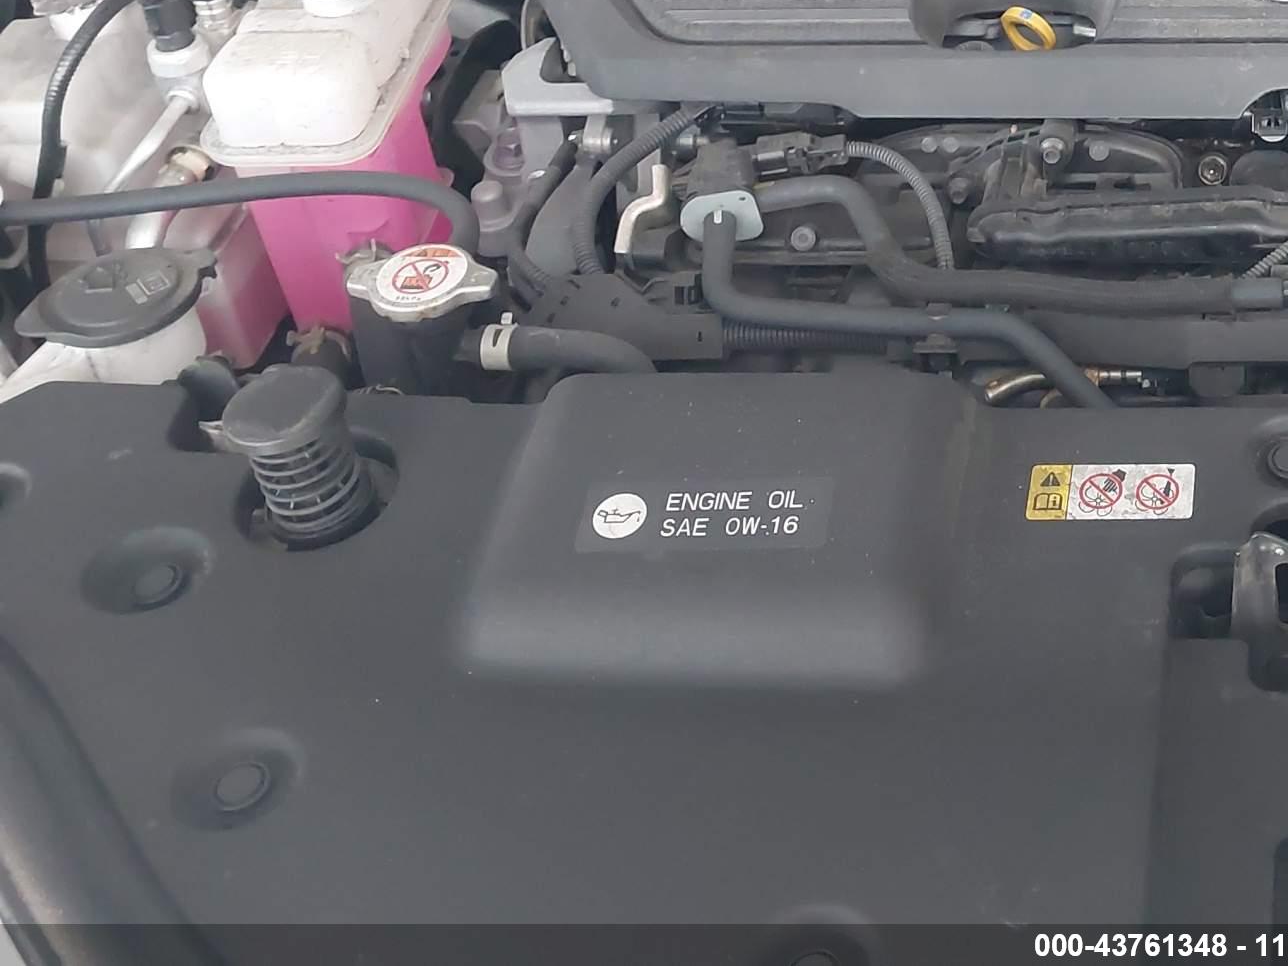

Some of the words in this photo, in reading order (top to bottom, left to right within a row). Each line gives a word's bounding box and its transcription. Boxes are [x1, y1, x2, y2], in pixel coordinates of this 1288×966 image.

[665, 491, 753, 512] ENGINE
[768, 489, 804, 509] OIL
[660, 517, 710, 537] SAE
[725, 515, 799, 536] 0W-16
